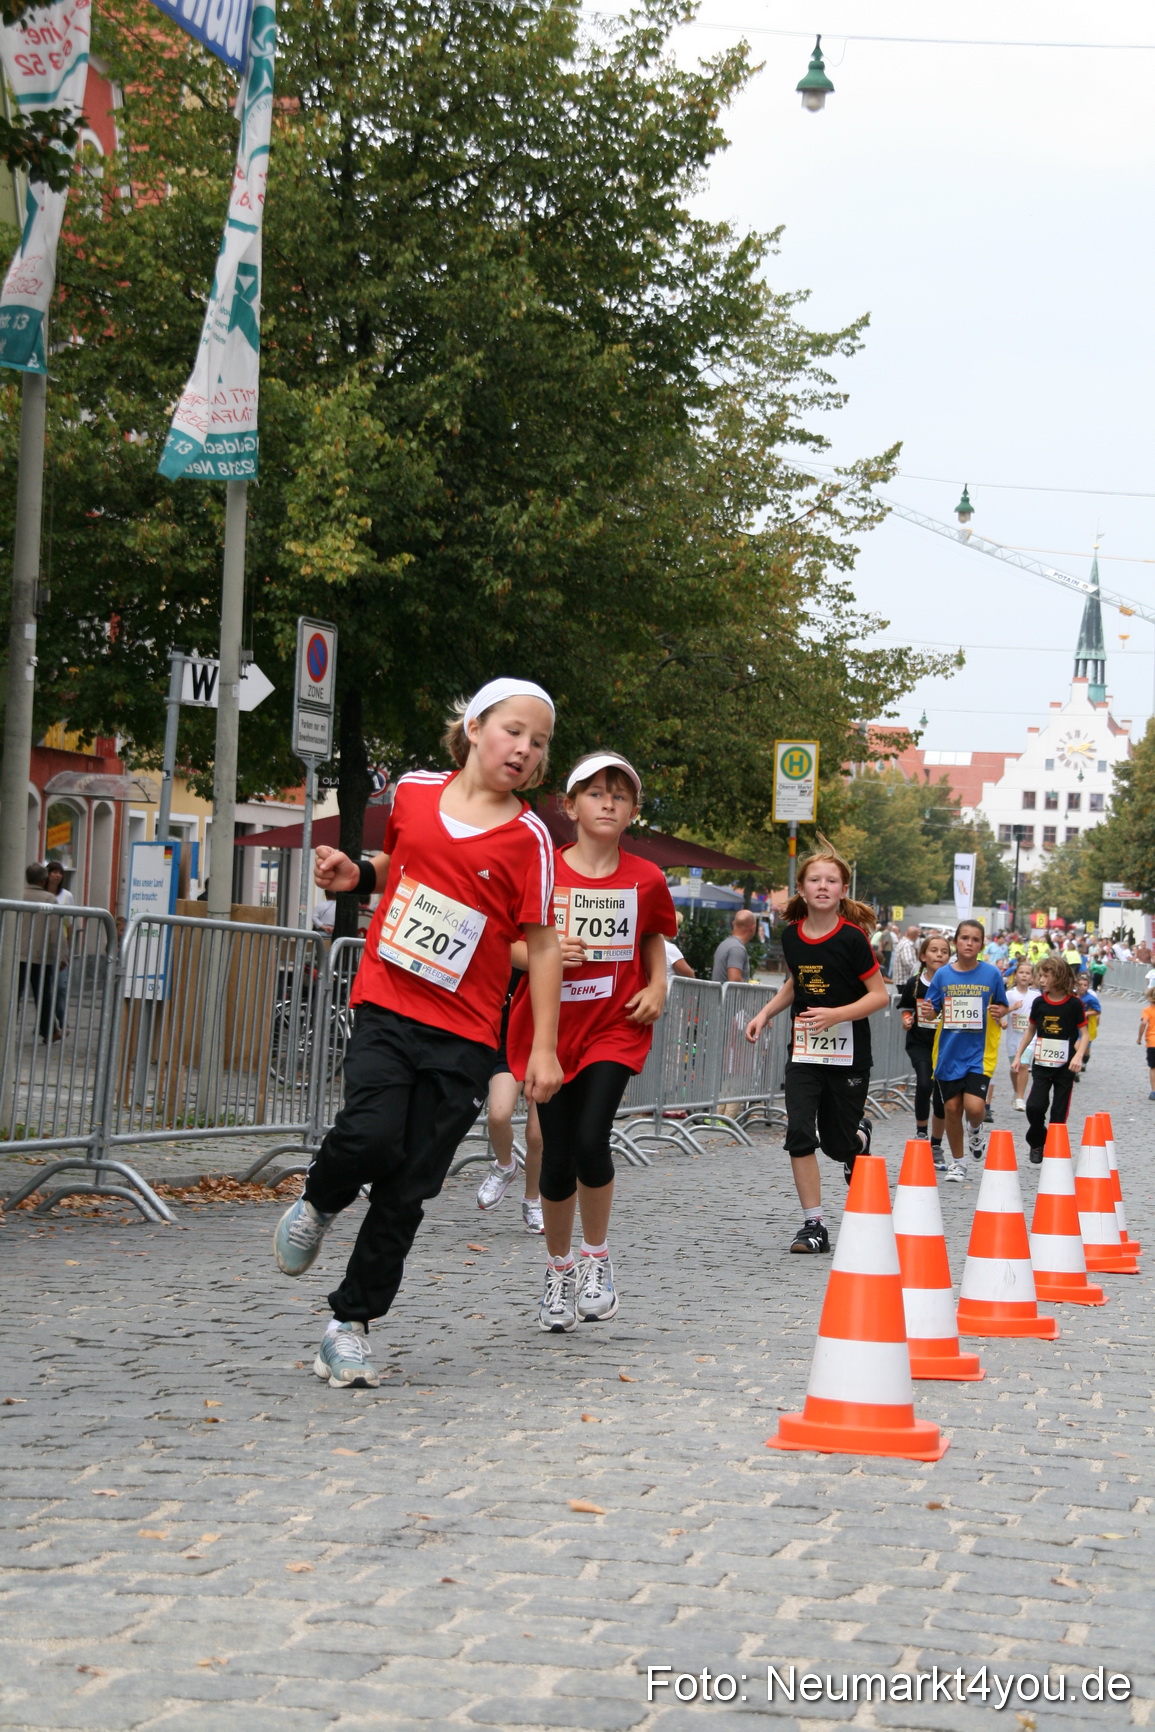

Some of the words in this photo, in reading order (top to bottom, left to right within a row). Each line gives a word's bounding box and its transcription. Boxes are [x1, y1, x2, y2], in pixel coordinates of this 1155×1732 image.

[12, 314, 30, 330] 13
[174, 439, 193, 455] 13
[1053, 572, 1080, 586] POTAIN
[307, 685, 324, 699] ZONE
[301, 718, 313, 729] Parken
[788, 754, 804, 773] H
[133, 877, 141, 887] Was
[142, 878, 153, 887] unser
[153, 877, 163, 887] Land
[574, 894, 625, 909] Christina
[575, 917, 629, 937] 7034
[404, 917, 467, 961] 7207
[603, 949, 633, 957] PFLEIDERER
[422, 964, 458, 986] PFLEIDERER
[571, 985, 597, 996] DEHN
[947, 984, 990, 992] NEUMARKTER
[953, 1009, 979, 1019] 7196
[810, 1036, 848, 1050] 7217
[1042, 1050, 1066, 1060] 7282
